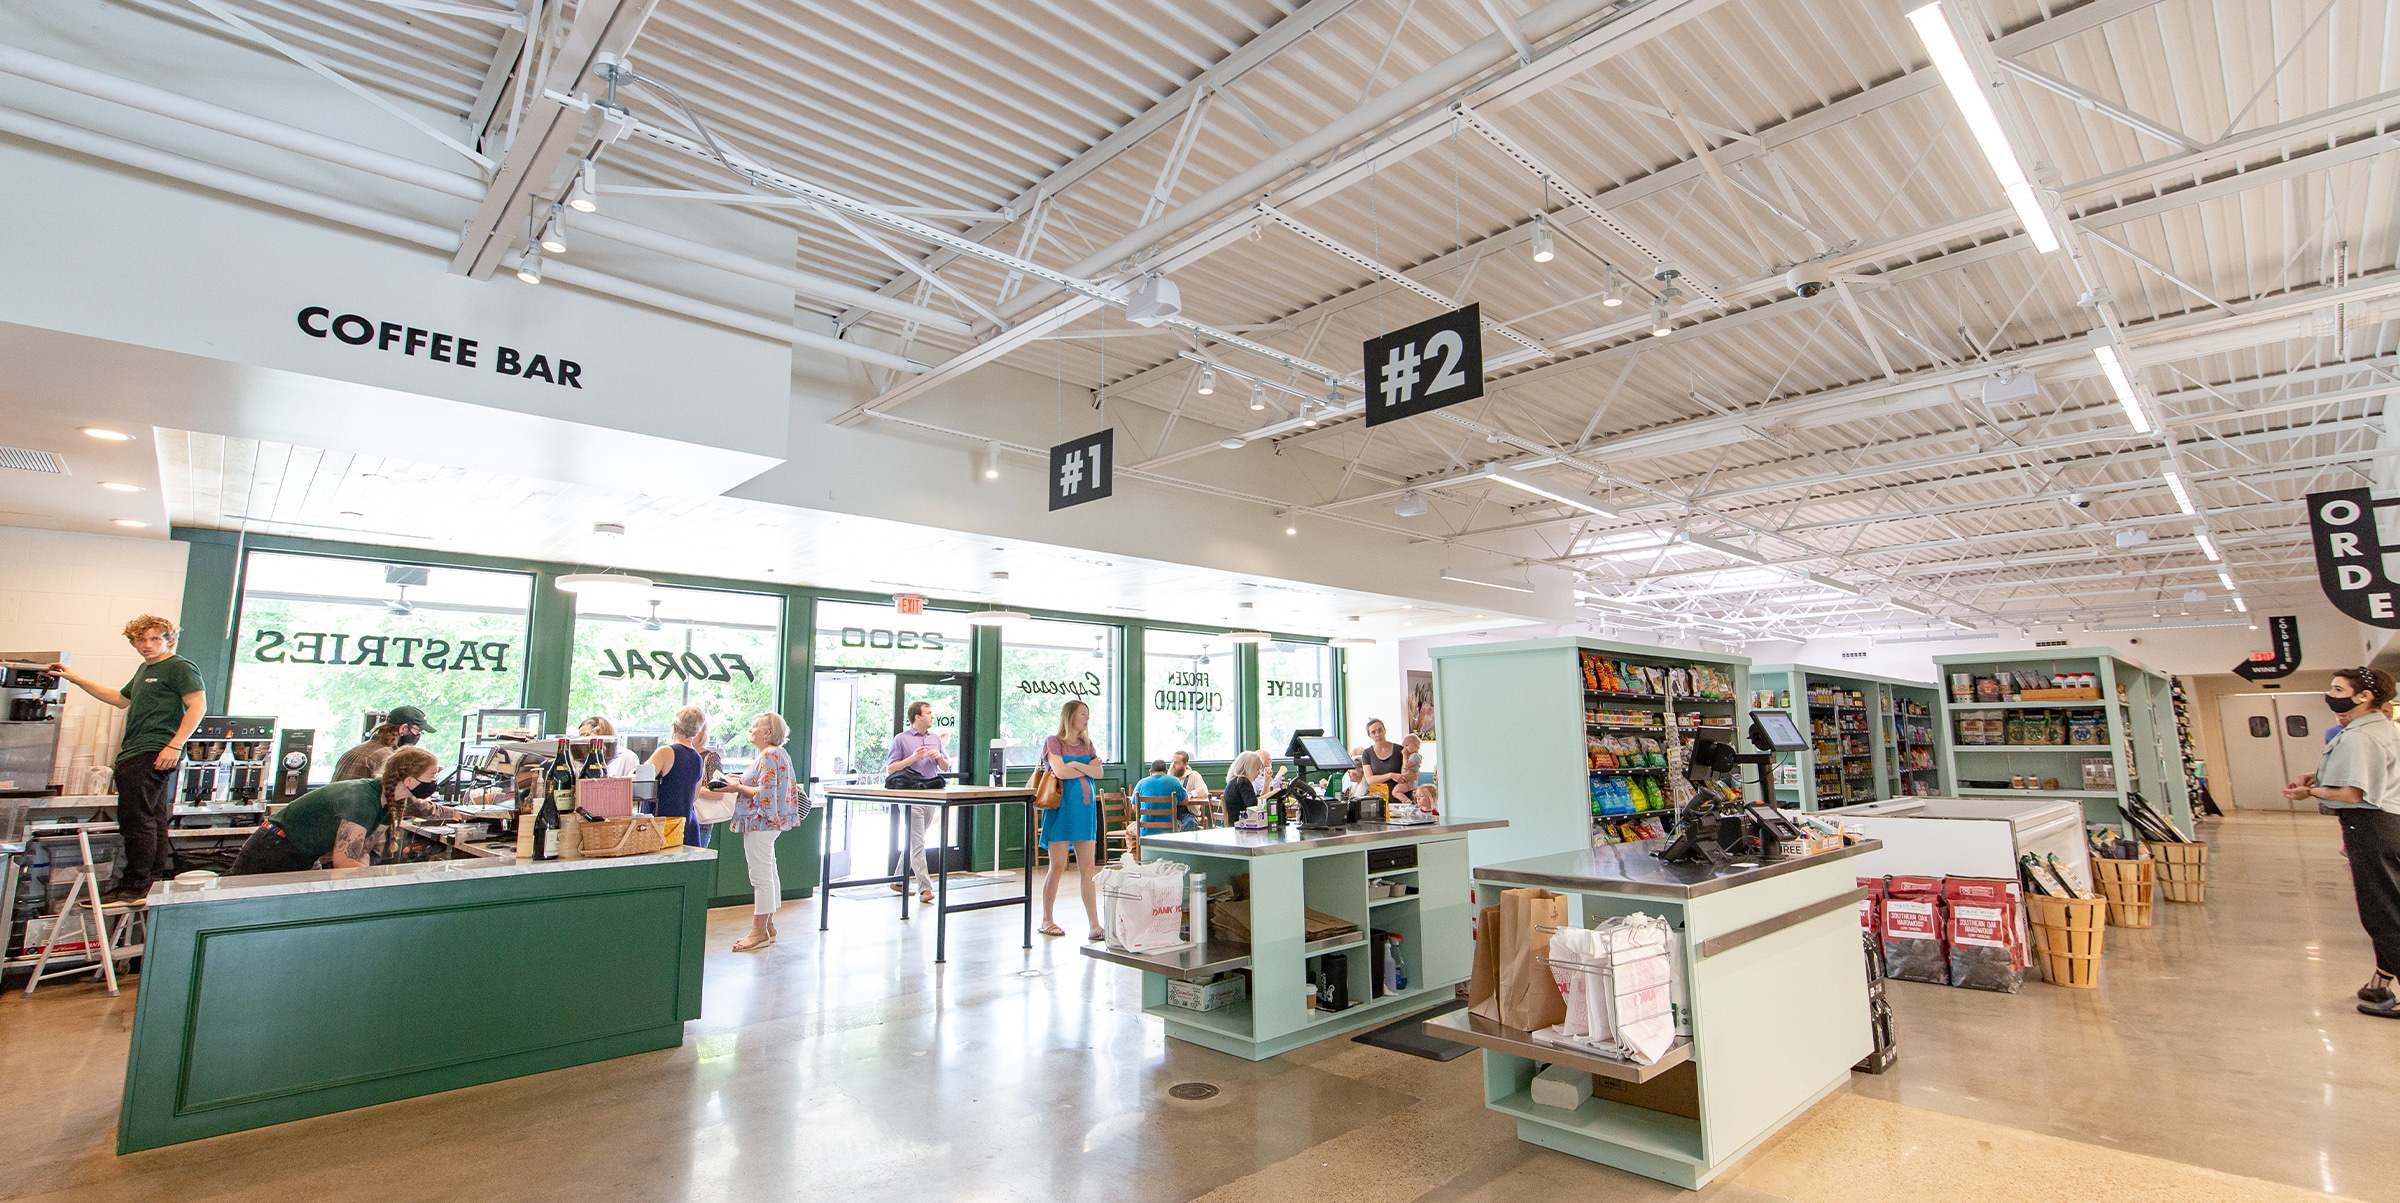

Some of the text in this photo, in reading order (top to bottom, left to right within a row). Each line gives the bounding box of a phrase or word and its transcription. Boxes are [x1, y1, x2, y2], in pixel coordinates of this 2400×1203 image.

[297, 306, 583, 389] COFFEE BAR
[1380, 329, 1466, 408] #2
[1060, 443, 1101, 497] #1
[901, 598, 920, 614] EXIT
[2279, 618, 2290, 640] COLD
[1891, 912, 1916, 920] SOUTHERN
[1897, 919, 1924, 927] HARDWOOD
[1959, 919, 1986, 927] SOUTHERN
[1965, 926, 1993, 935] HARDWOOD
